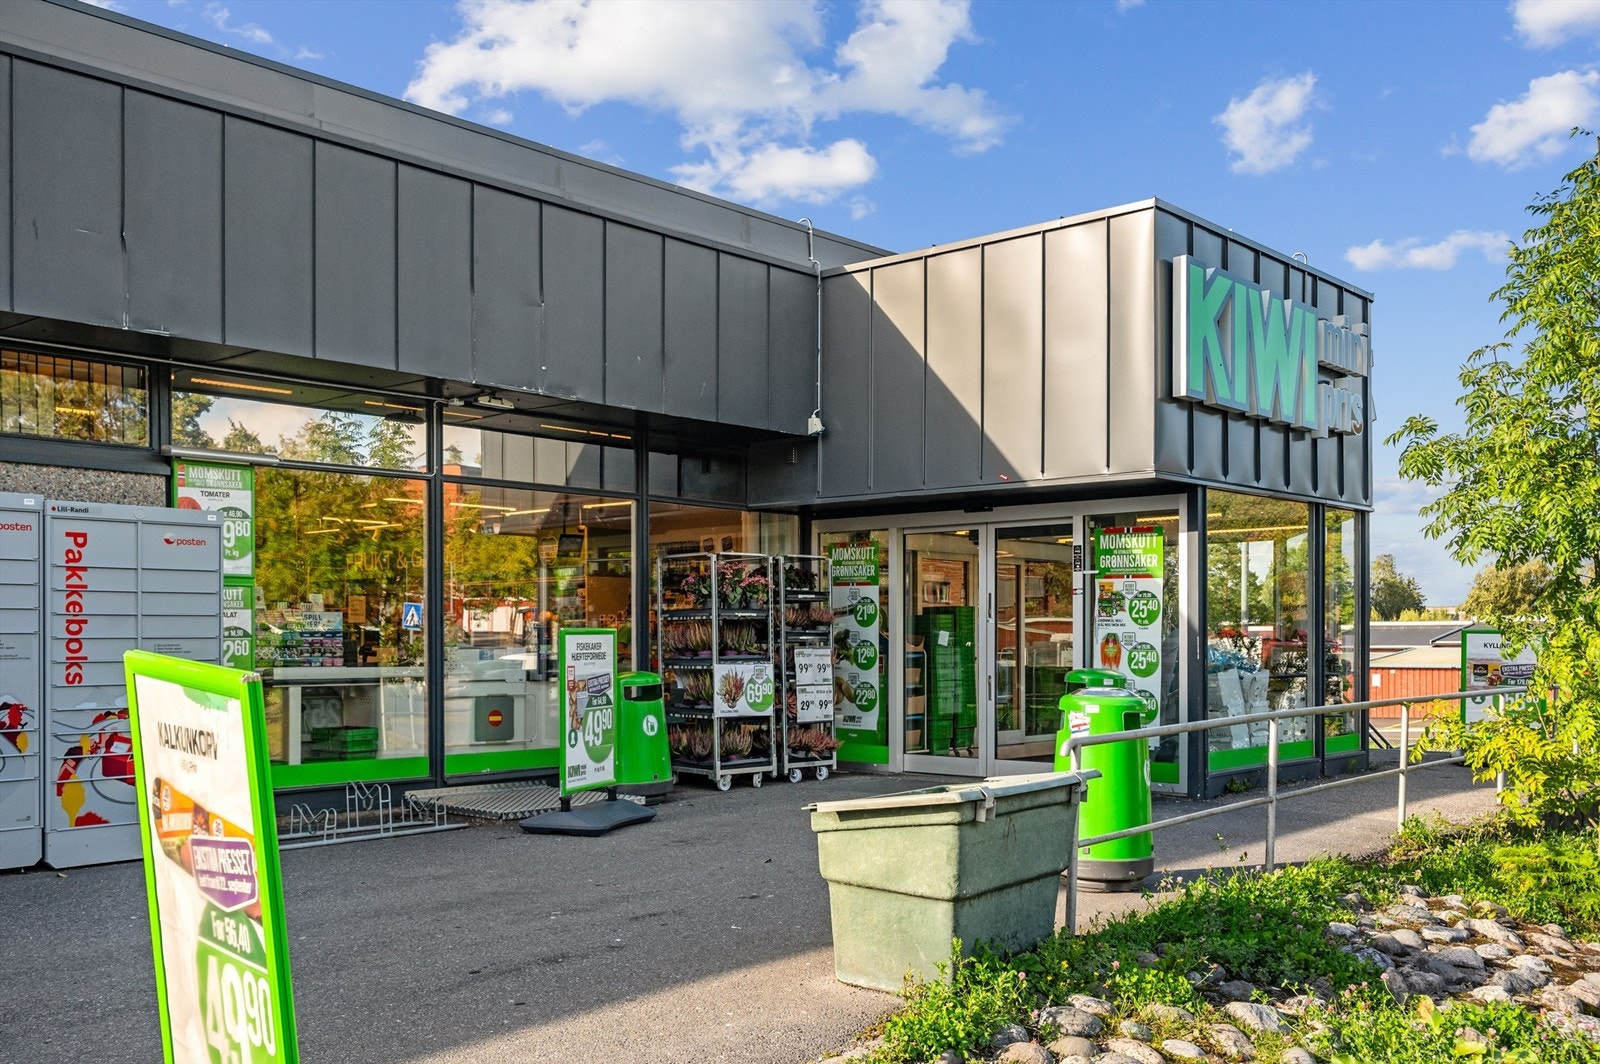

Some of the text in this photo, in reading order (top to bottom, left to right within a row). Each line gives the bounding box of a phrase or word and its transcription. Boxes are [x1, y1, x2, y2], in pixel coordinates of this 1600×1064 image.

[1186, 256, 1318, 431] KIWI
[1312, 375, 1364, 439] pris
[188, 466, 241, 481] MOMSKUTT
[176, 537, 206, 547] posten
[1100, 533, 1158, 550] MOMSKUTT
[346, 550, 393, 572] FRUKT
[832, 546, 875, 561] MOMSKUTT
[1100, 554, 1158, 568] GRØNNSAKER
[832, 564, 875, 577] GRØNNSAKER
[65, 531, 88, 685] Pakkeboks
